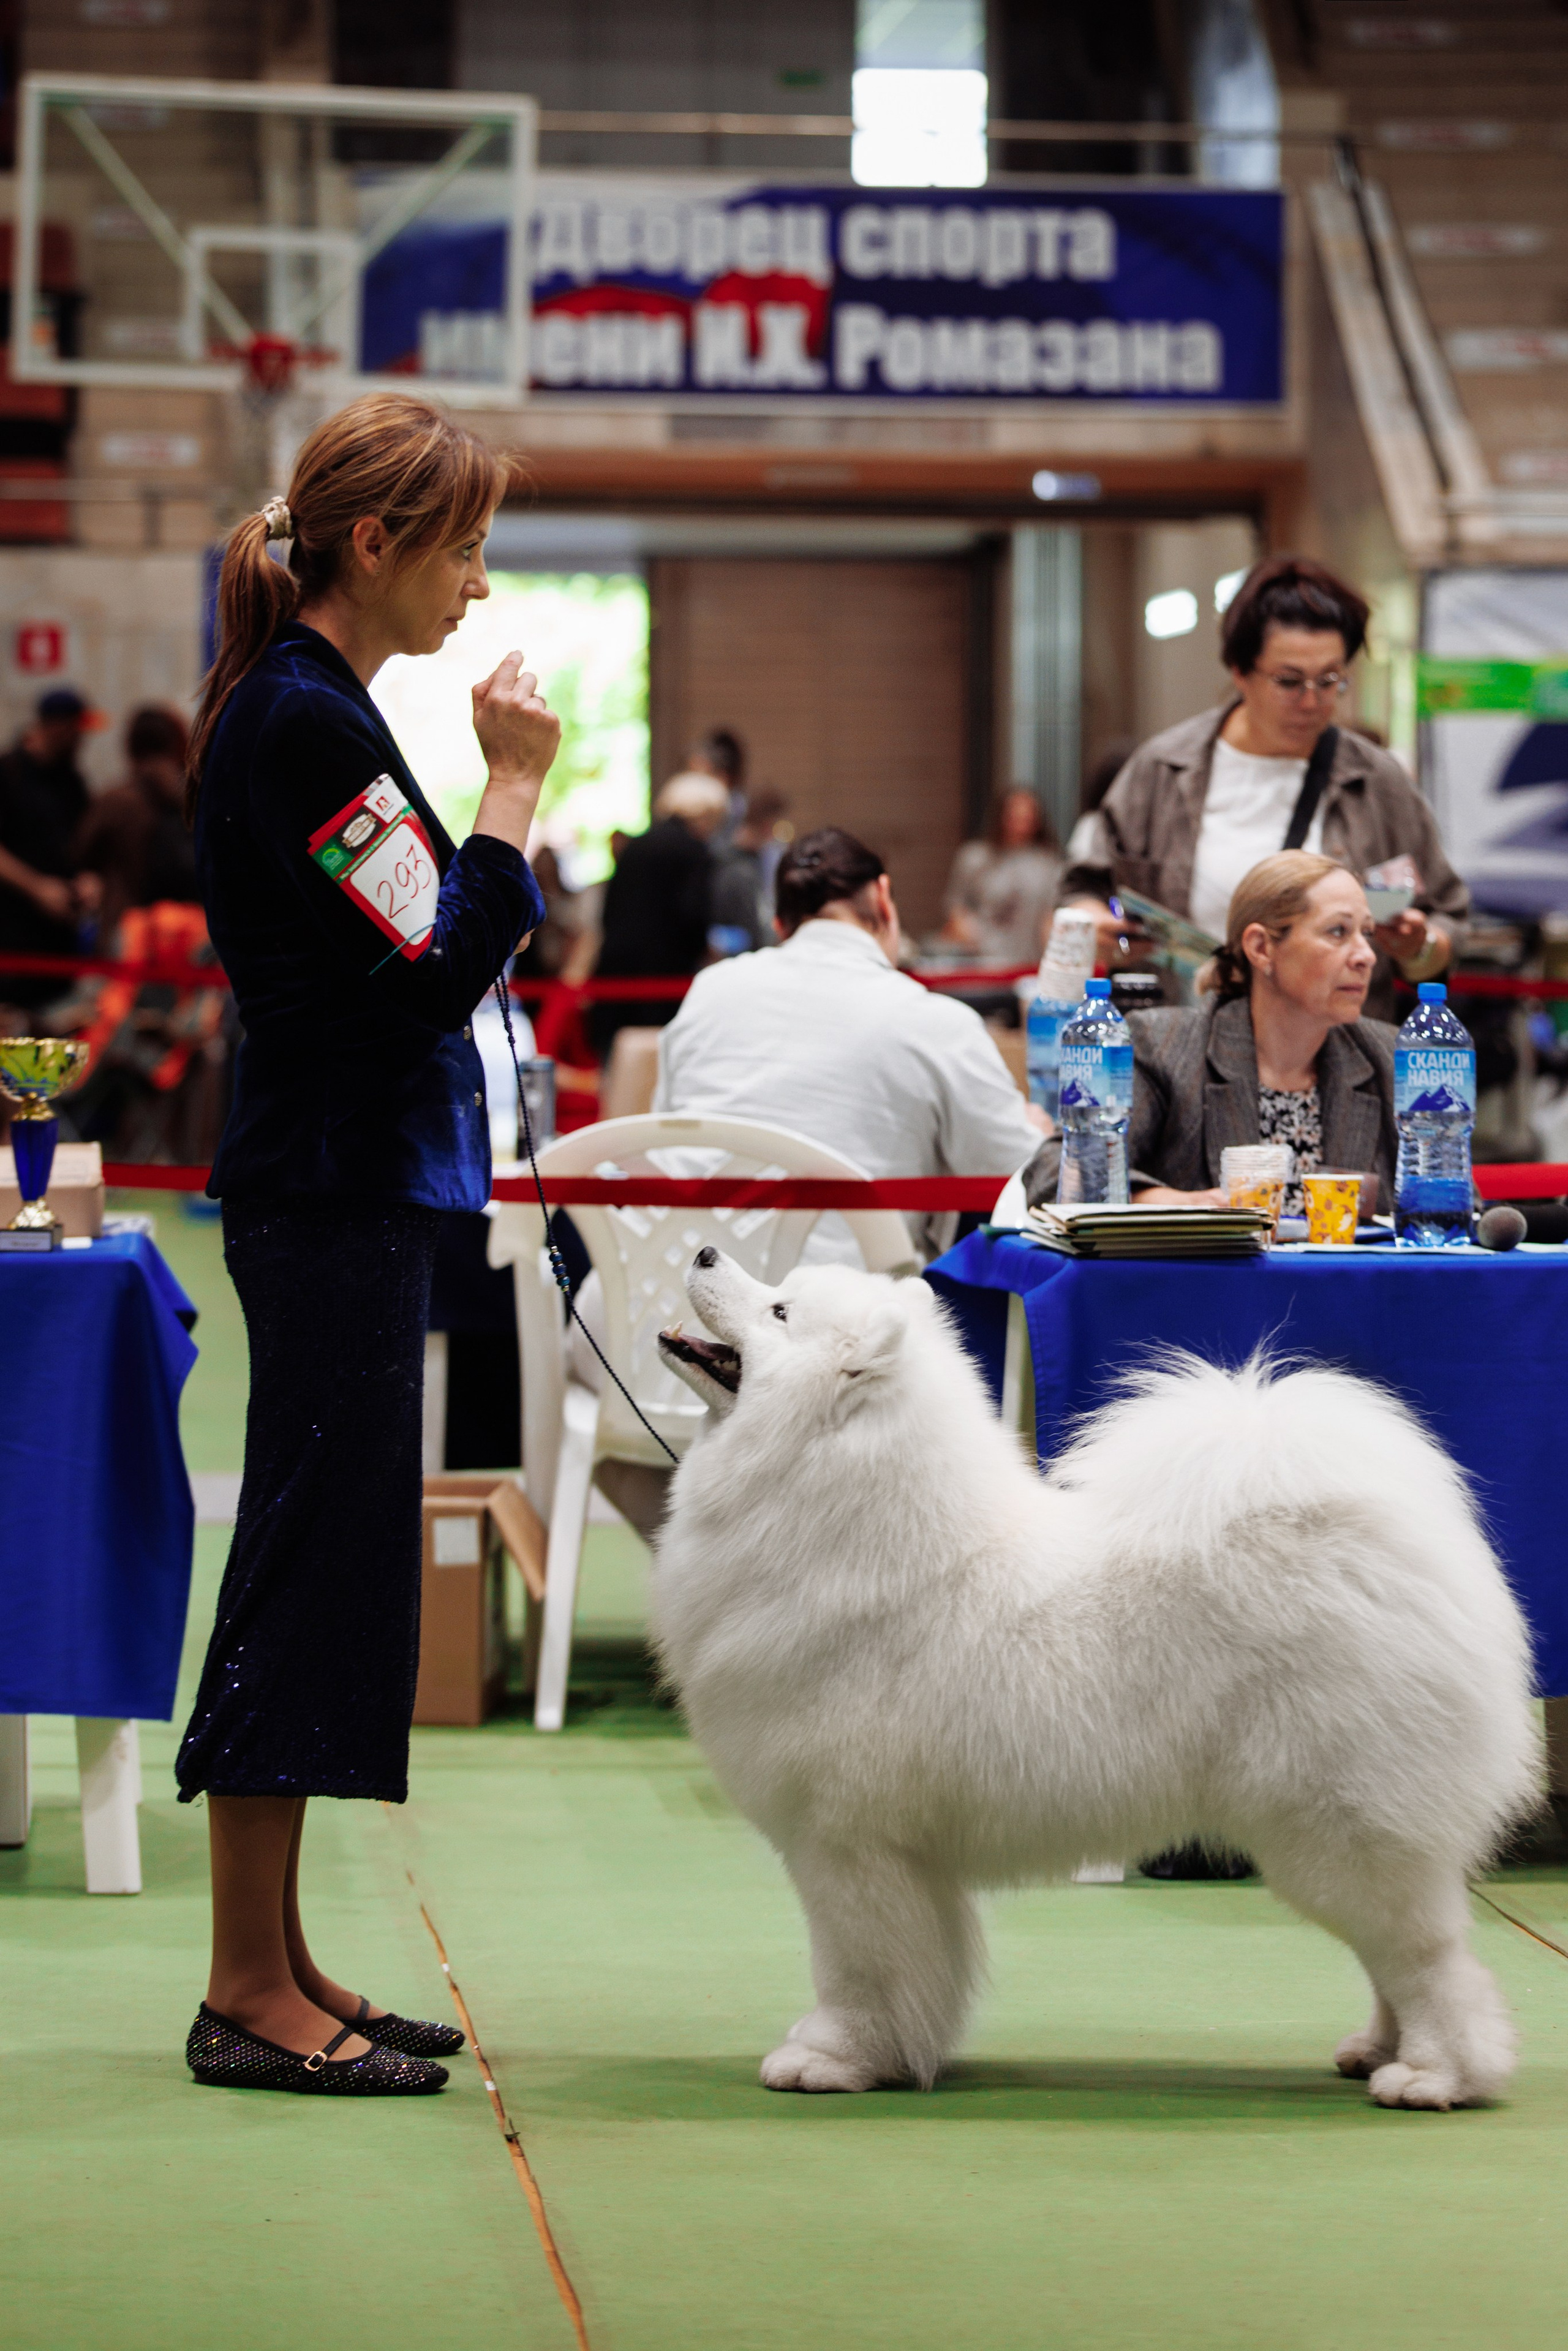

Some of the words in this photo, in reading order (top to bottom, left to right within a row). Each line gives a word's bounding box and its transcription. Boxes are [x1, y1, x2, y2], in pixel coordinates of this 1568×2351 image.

[533, 201, 828, 289] Дворец
[838, 203, 1118, 288] спорта
[833, 303, 1223, 393] Ромазана
[377, 843, 431, 919] 293
[1407, 1052, 1471, 1069] СКАНДИ
[1407, 1070, 1464, 1086] НАВИЯ
